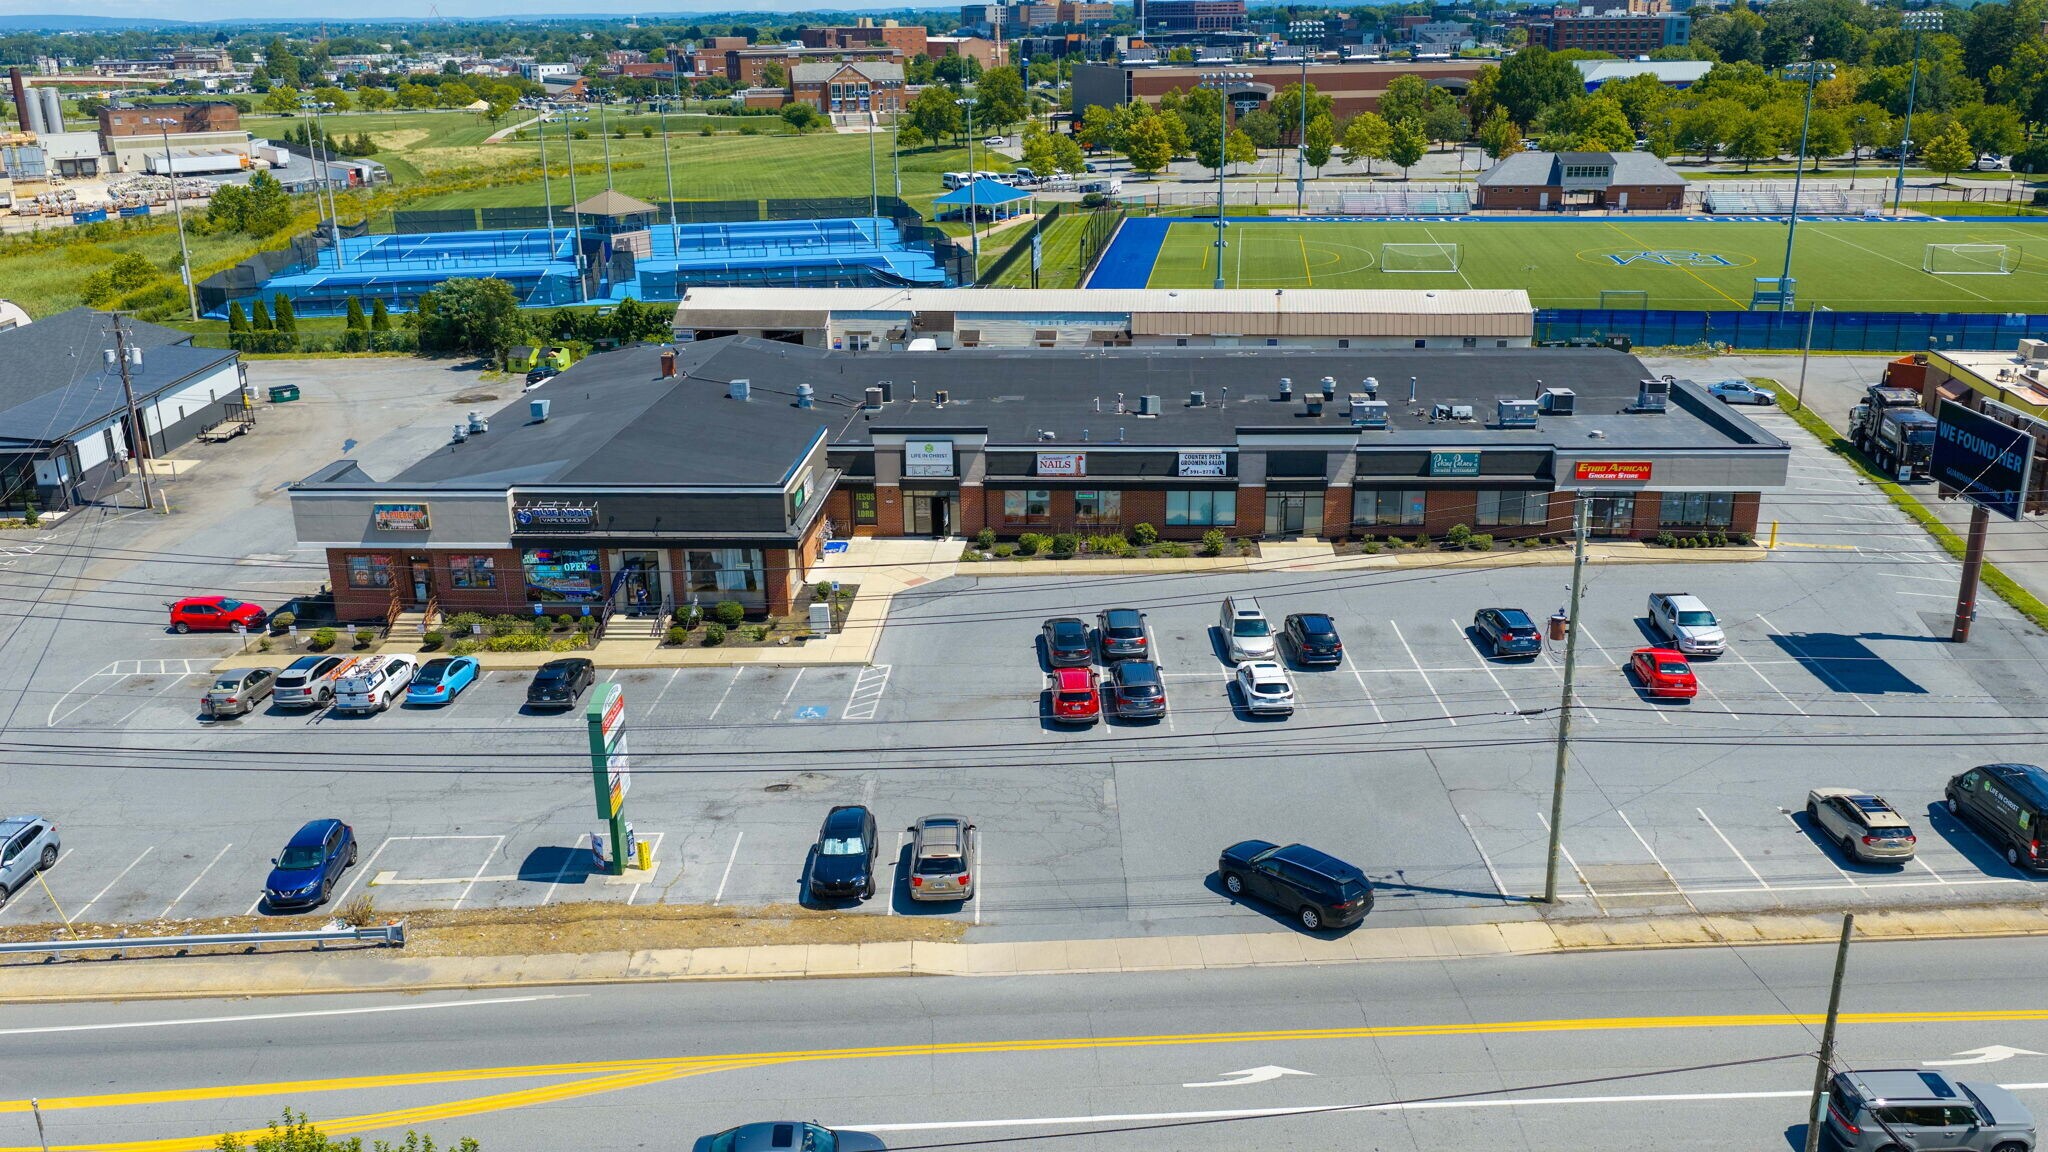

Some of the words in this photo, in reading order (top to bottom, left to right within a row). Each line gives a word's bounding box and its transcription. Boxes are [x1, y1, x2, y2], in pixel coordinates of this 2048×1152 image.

[1939, 421, 1956, 443] WE
[1957, 430, 1996, 461] FOUND
[1997, 448, 2022, 473] HER
[1039, 460, 1071, 469] NAILS
[1608, 463, 1650, 472] AFRICAN
[856, 493, 875, 501] JESUS
[862, 501, 869, 509] IS
[532, 508, 559, 517] BLUE
[560, 508, 593, 517] APPLE
[857, 510, 875, 518] LORD
[564, 562, 587, 571] OPEN
[1989, 787, 1999, 797] LIFE
[2002, 795, 2020, 812] CHRIST
